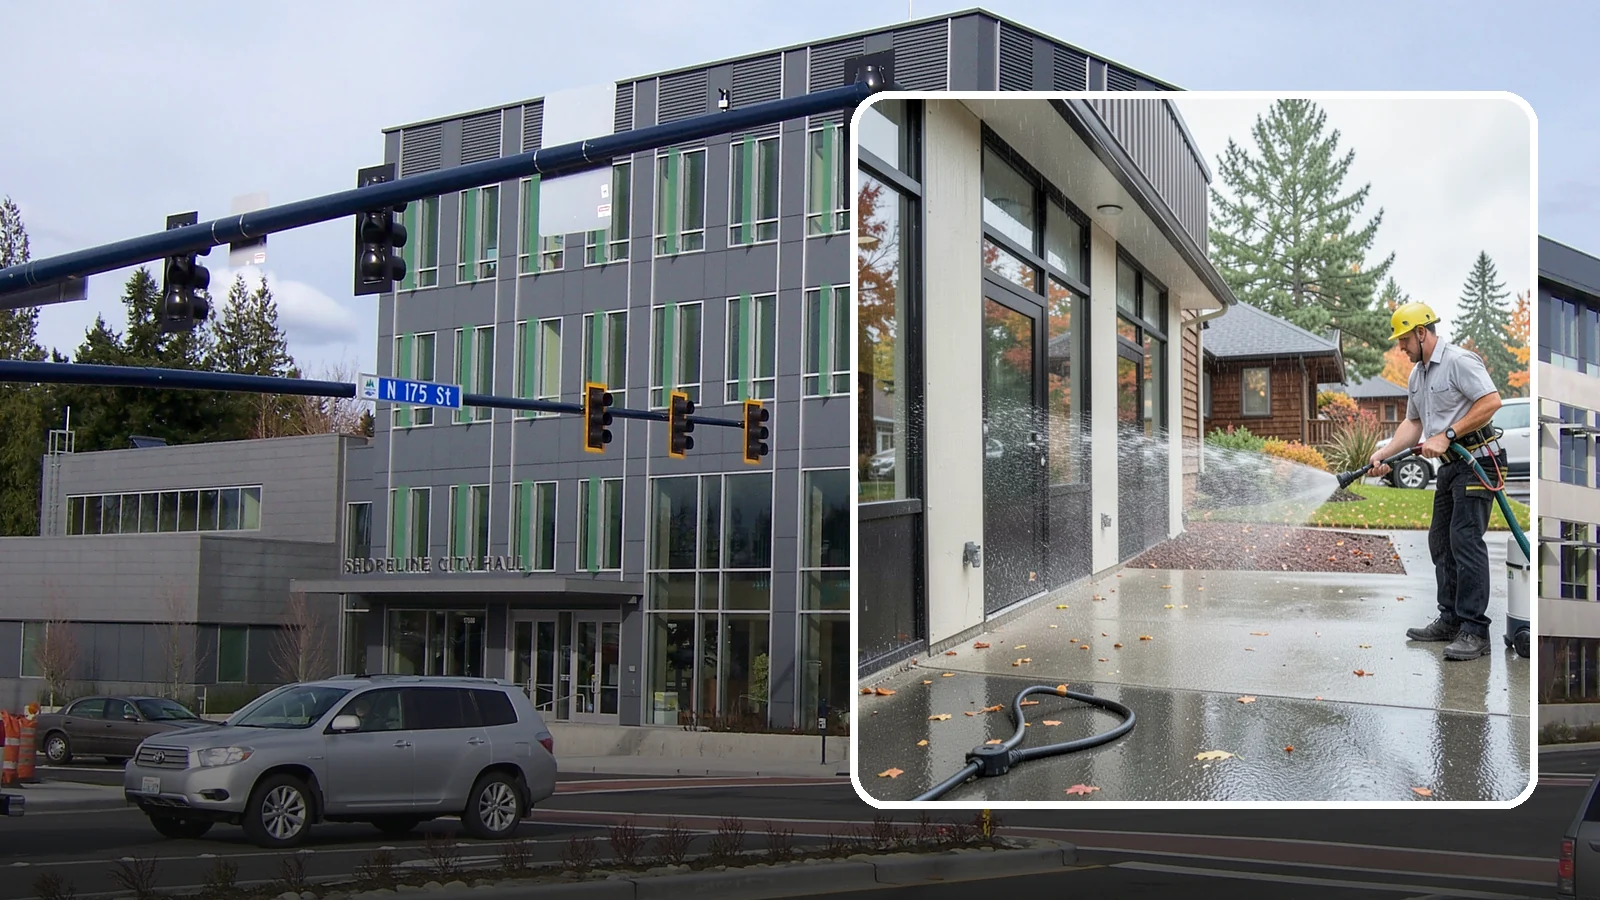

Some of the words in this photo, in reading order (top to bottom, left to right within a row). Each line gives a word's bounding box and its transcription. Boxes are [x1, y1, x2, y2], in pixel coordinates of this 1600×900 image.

[387, 380, 396, 399] N
[405, 382, 427, 403] 175
[436, 386, 451, 406] St
[344, 557, 431, 574] SHORELINE
[438, 556, 475, 572] CITY
[484, 555, 525, 571] HALL
